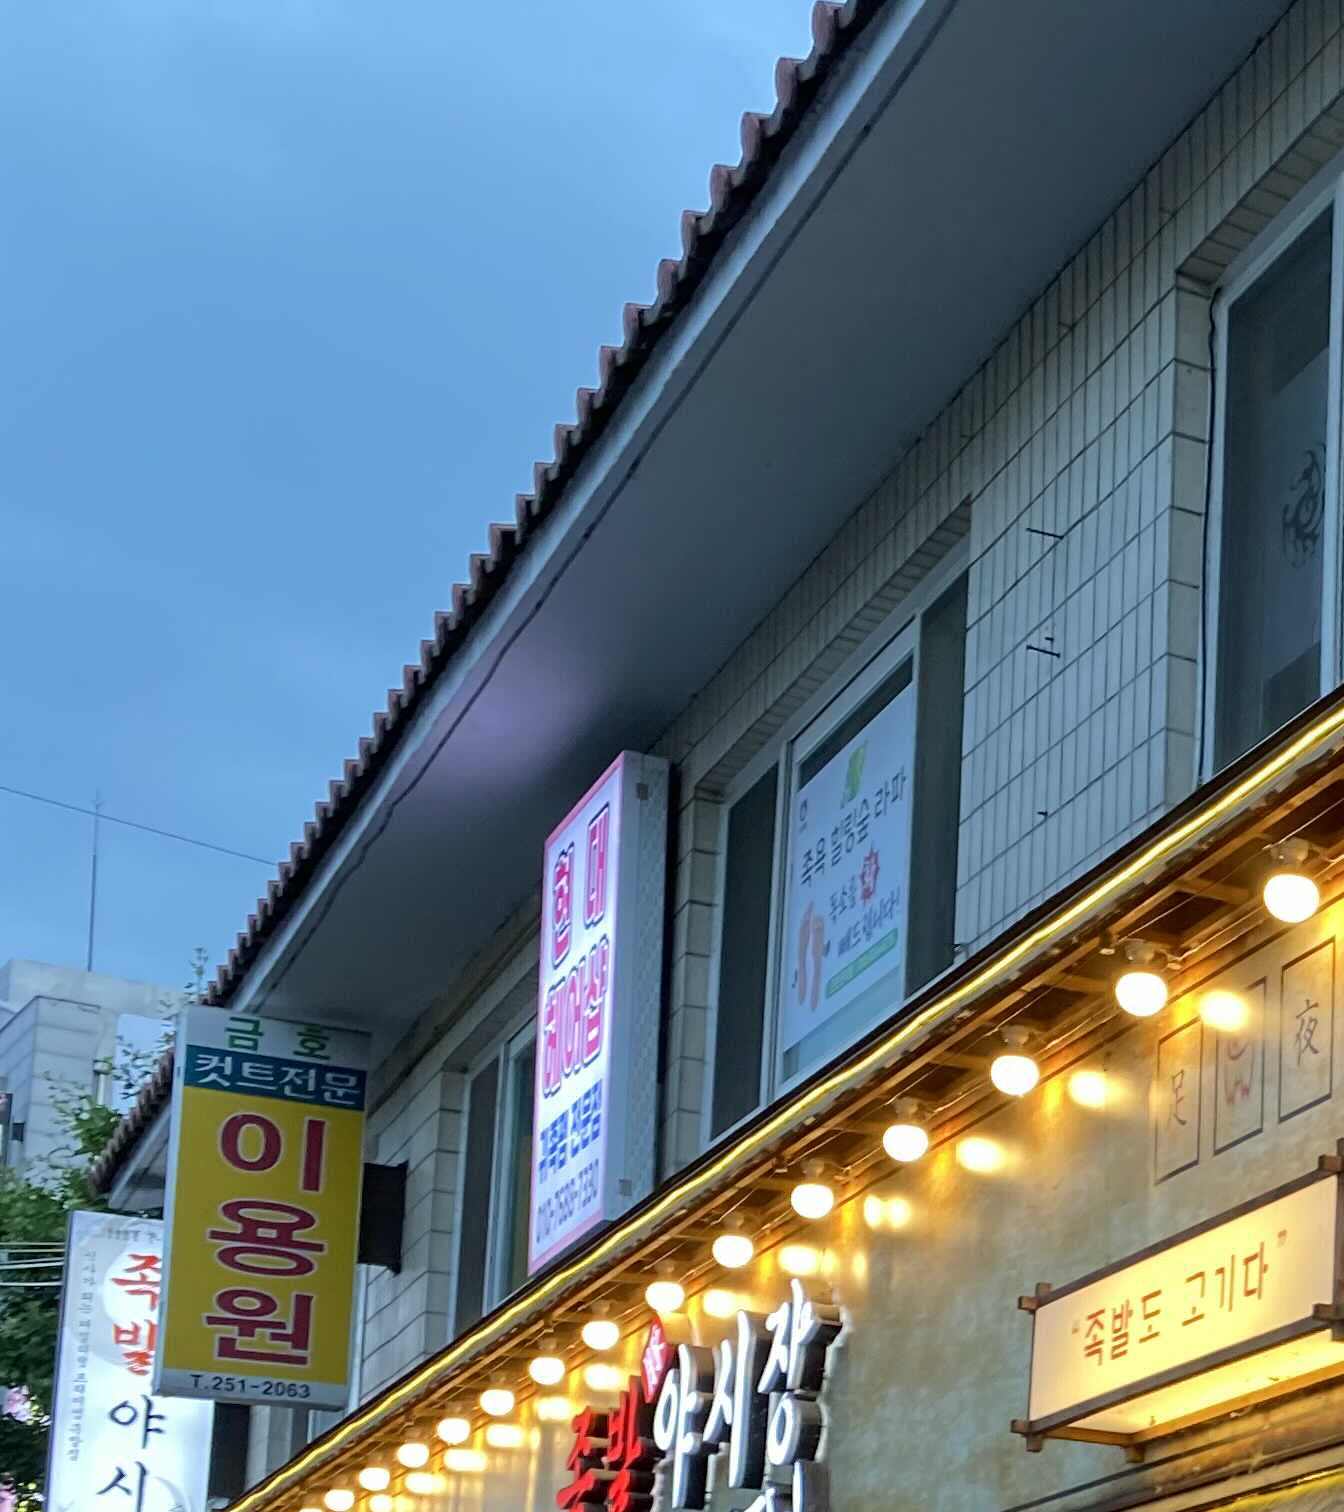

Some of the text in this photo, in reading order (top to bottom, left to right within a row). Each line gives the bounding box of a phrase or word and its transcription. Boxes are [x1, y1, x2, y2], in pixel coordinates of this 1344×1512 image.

[226, 1016, 332, 1061] 금호
[196, 1053, 361, 1107] 컷트전문
[205, 1112, 326, 1366] 이용원
[190, 1373, 311, 1400] T.251-2063
